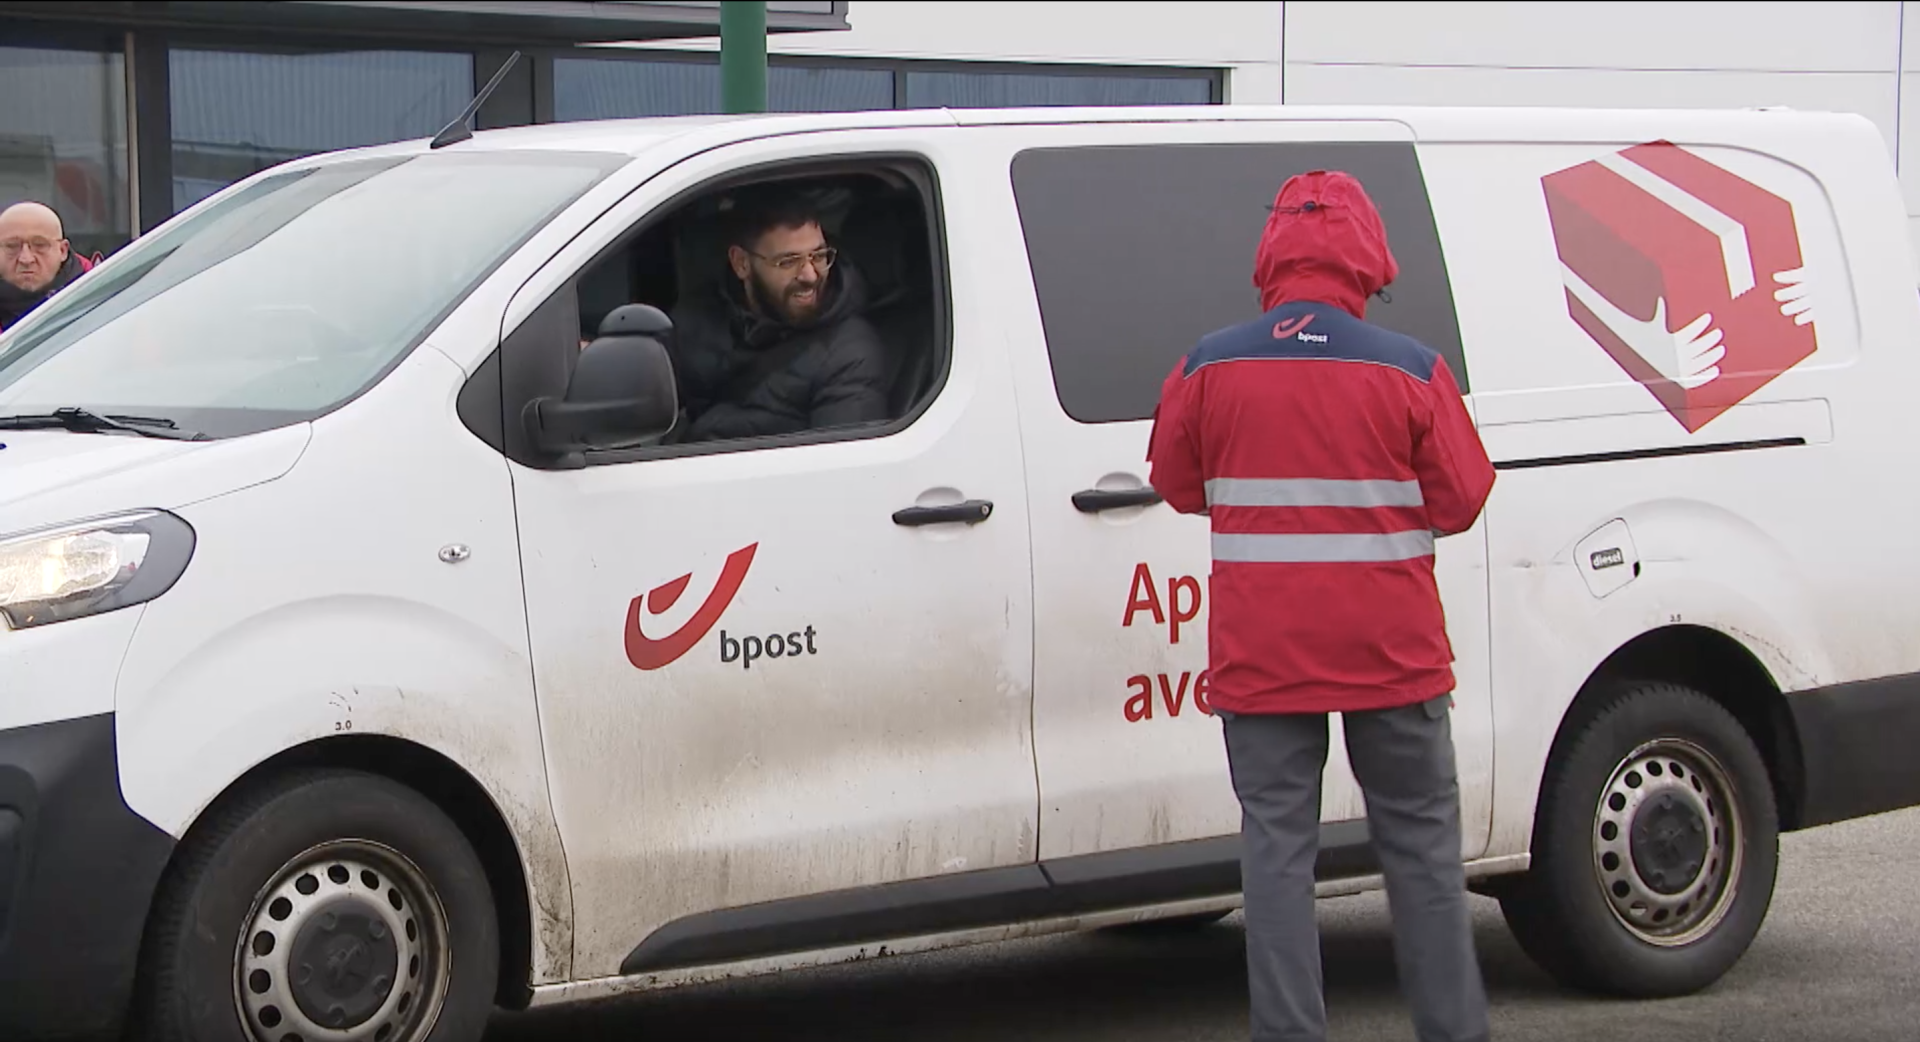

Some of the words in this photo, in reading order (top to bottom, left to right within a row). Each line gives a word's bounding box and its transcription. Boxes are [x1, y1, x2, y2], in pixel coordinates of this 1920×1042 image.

[1298, 331, 1328, 343] bpost
[1593, 550, 1621, 567] diesel
[1122, 562, 1210, 644] Ap
[720, 624, 817, 669] bpost
[1124, 669, 1214, 722] ave
[335, 719, 352, 731] 3.0
